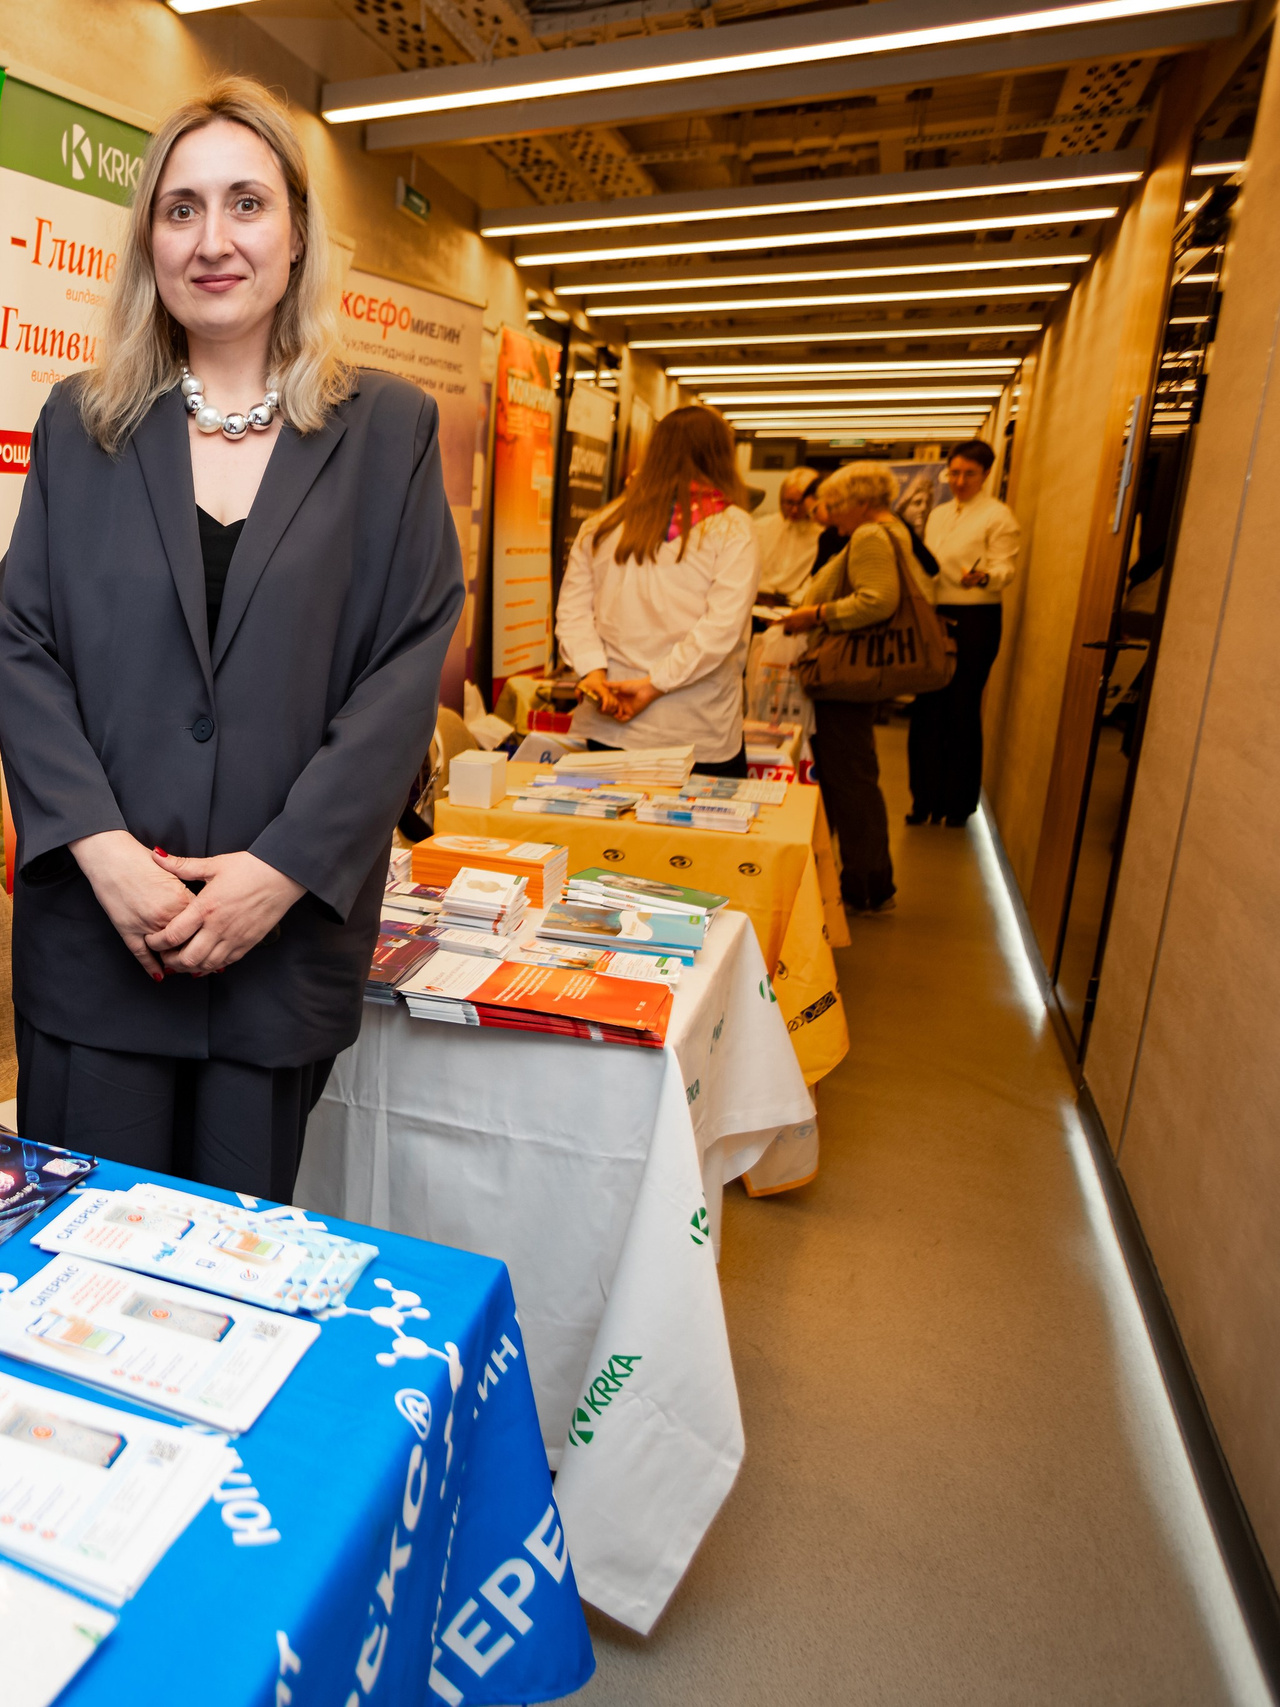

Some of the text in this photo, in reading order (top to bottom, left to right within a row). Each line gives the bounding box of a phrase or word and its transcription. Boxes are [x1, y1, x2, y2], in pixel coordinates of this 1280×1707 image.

[56, 1196, 109, 1241] САТЕРЕКС
[30, 1263, 80, 1308] САТЕРЕКС
[583, 1354, 643, 1416] KRKA
